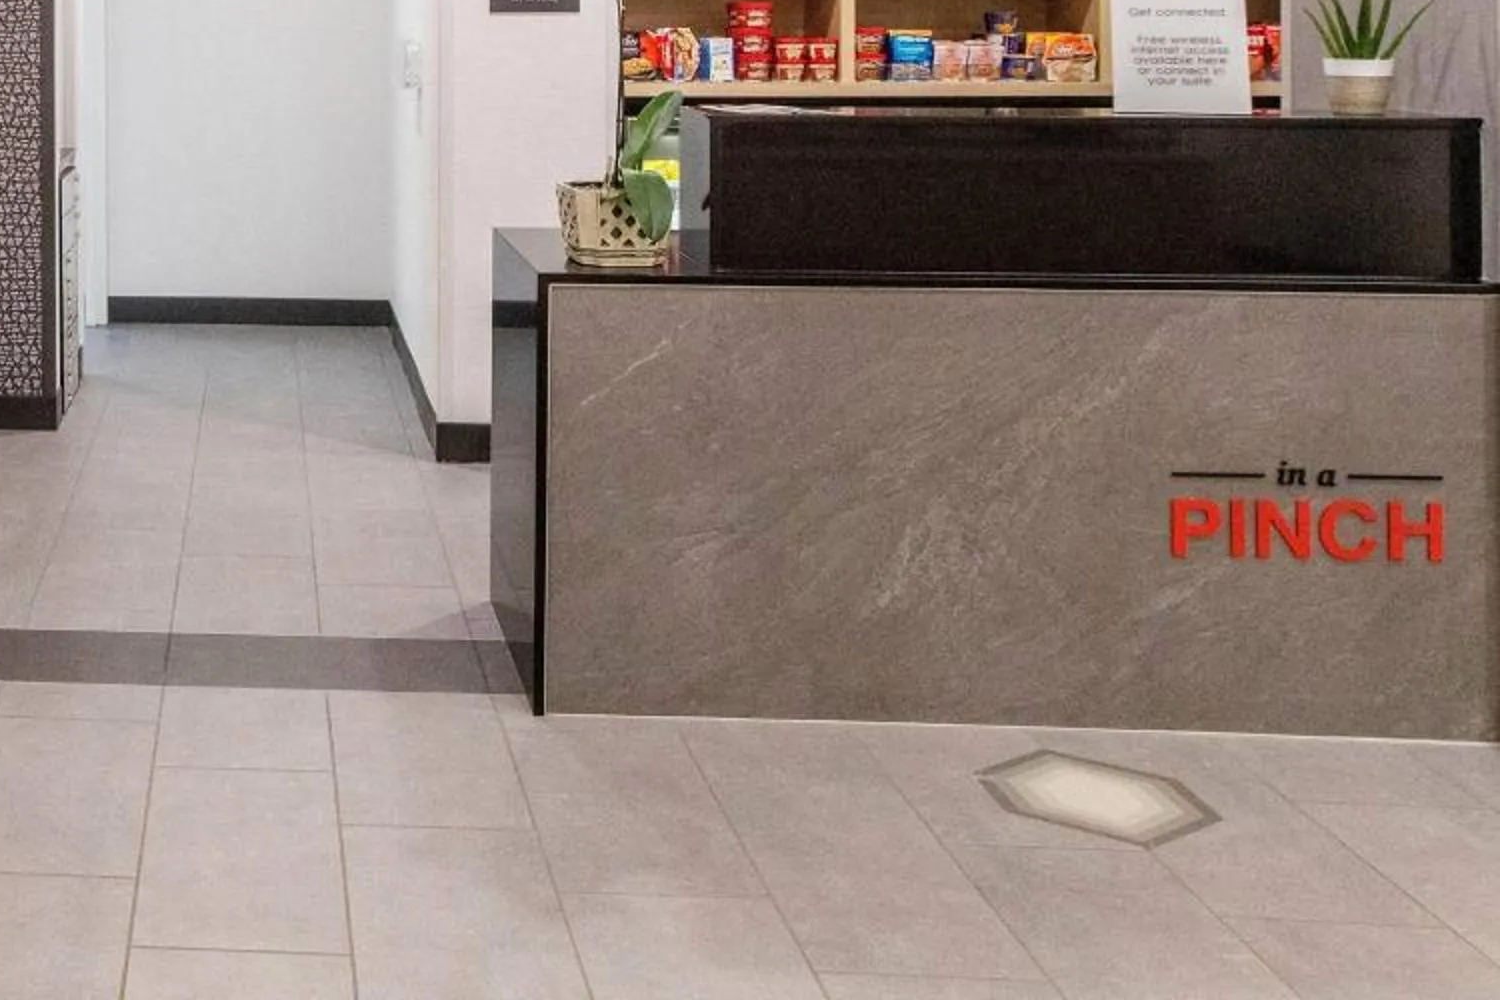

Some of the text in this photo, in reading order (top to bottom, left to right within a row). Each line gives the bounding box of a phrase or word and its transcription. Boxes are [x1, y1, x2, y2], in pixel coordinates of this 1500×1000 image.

[1128, 7, 1151, 17] Get
[1136, 35, 1166, 45] Free
[1130, 46, 1230, 55] internet access
[1133, 56, 1227, 65] available here
[1138, 67, 1152, 75] or
[1155, 66, 1209, 75] connect
[1147, 77, 1177, 87] your
[1276, 461, 1338, 487] in a
[1169, 496, 1445, 563] PINCH
